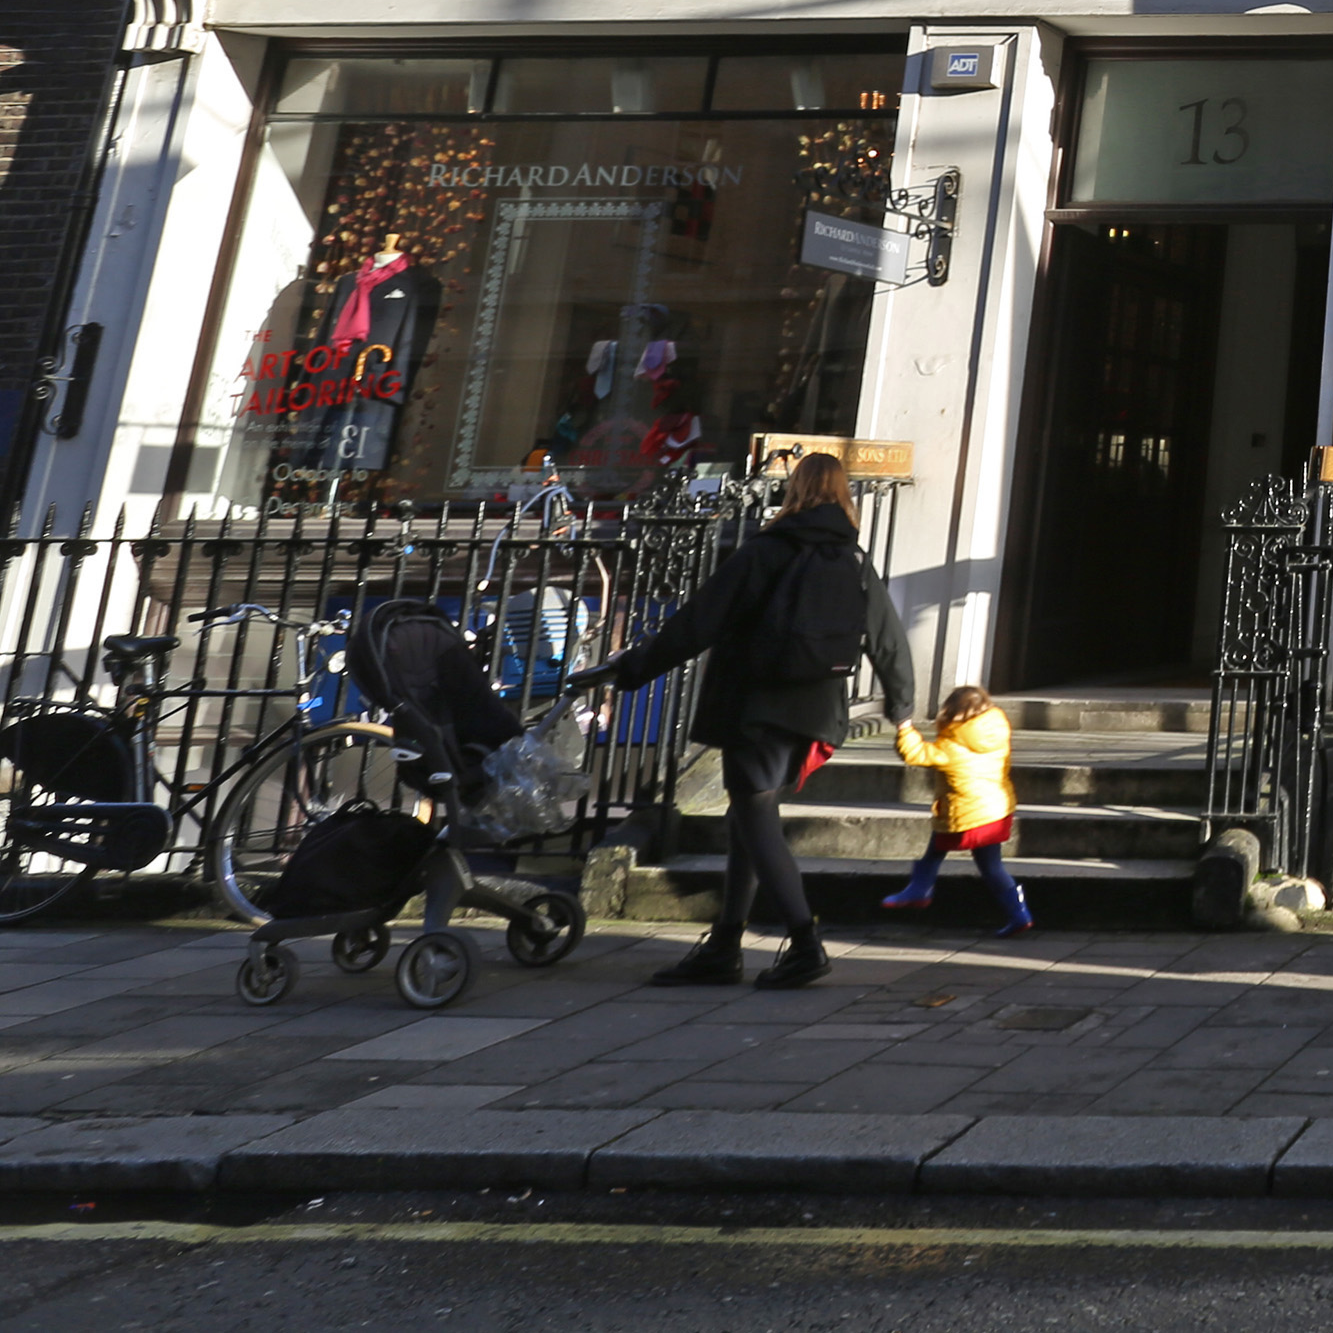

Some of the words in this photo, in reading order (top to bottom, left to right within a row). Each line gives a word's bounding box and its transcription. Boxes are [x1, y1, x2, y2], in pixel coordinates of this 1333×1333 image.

[947, 58, 978, 72] ADT
[1179, 98, 1250, 165] 13
[244, 329, 273, 342] THE
[233, 350, 297, 383] ART
[305, 345, 350, 373] OF
[229, 370, 402, 419] TAILORING
[857, 447, 885, 463] SONS
[887, 448, 908, 463] LTD
[272, 462, 347, 482] October
[352, 465, 368, 482] to
[266, 496, 357, 517] December
